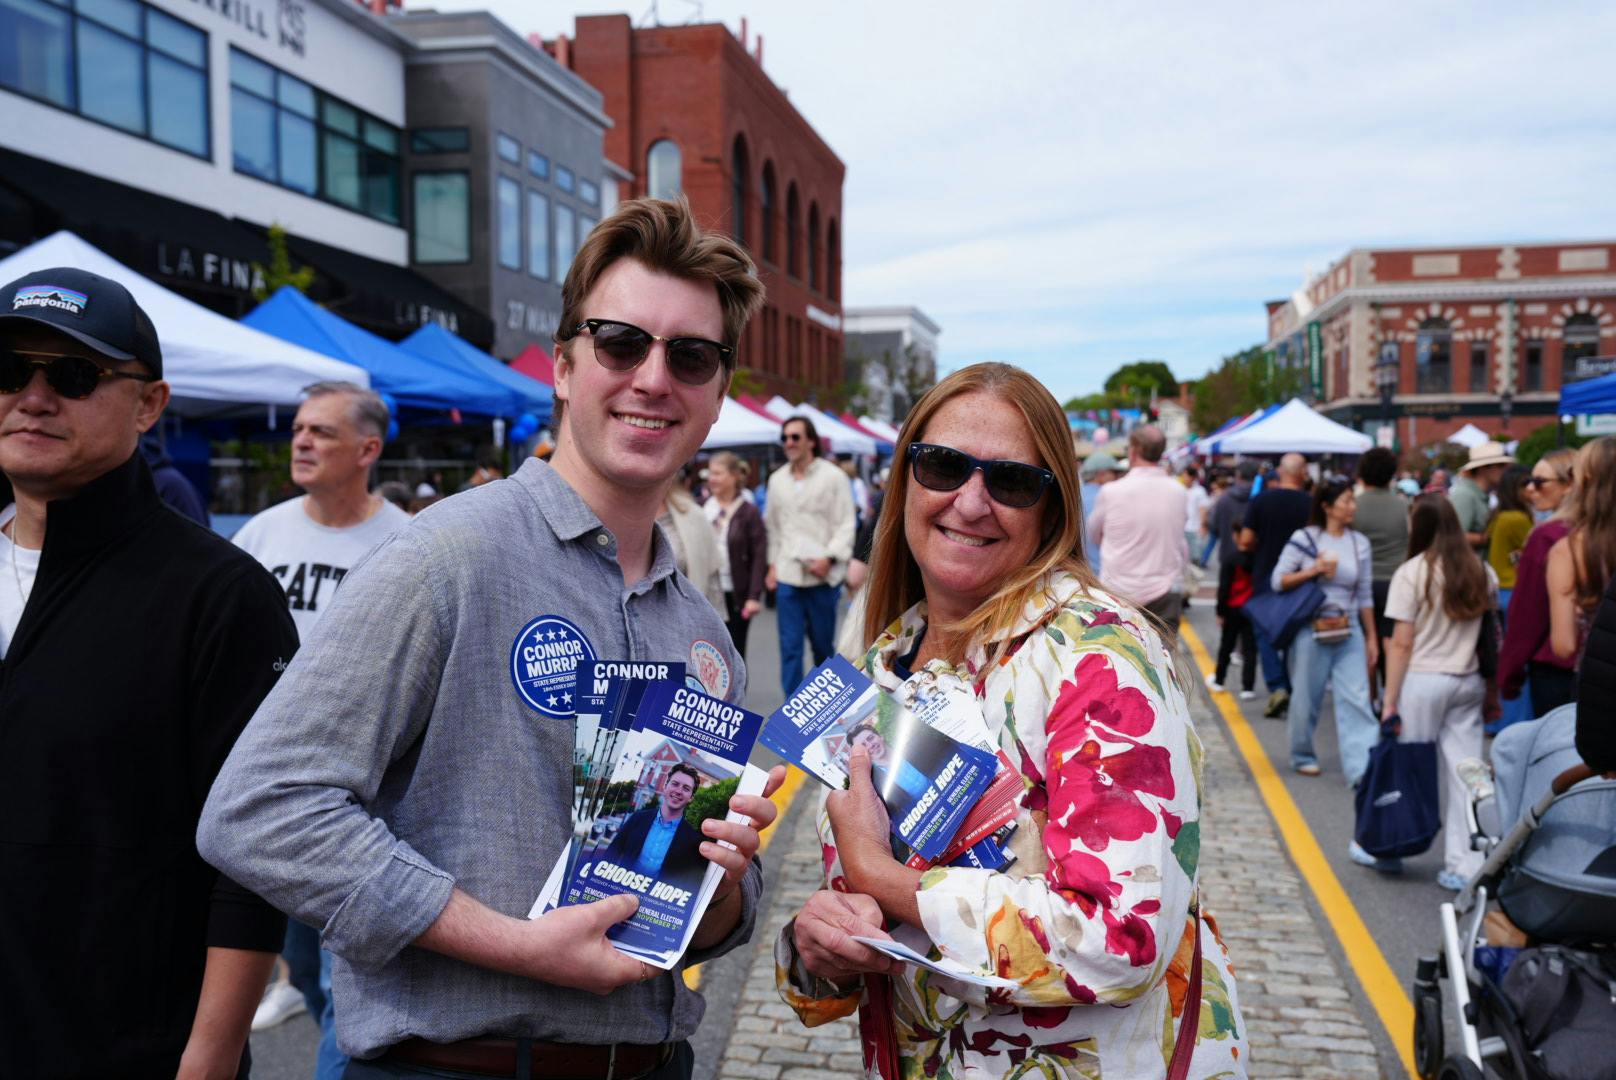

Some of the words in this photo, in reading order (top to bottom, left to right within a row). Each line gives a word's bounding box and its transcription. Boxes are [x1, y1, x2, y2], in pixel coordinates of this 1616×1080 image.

[158, 241, 196, 279] LA
[203, 252, 267, 291] FINA
[13, 297, 80, 313] patagonia
[523, 639, 583, 662] CONNOR
[533, 677, 551, 688] STATE
[593, 663, 669, 680] CONNOR
[591, 698, 606, 706] STA
[674, 688, 744, 726] CONNOR
[782, 668, 837, 718] CONNOR
[791, 676, 846, 728] MURRAY
[802, 721, 818, 736] STATE
[816, 685, 856, 723] REPRESENTATIVE
[662, 719, 682, 732] STATE
[681, 726, 734, 752] REPRESENTATIVE
[667, 702, 741, 740] MURRAY
[698, 740, 721, 752] DISTRICT
[899, 785, 939, 837] CHOOSE
[935, 752, 964, 791] HOPE
[946, 783, 962, 803] GENERAL
[959, 765, 977, 785] ELECTION
[593, 860, 654, 893] CHOOSE
[649, 880, 693, 907] HOPE
[635, 912, 671, 928] NOVEMBER
[638, 905, 660, 920] GENERAL
[660, 913, 684, 926] ELECTION
